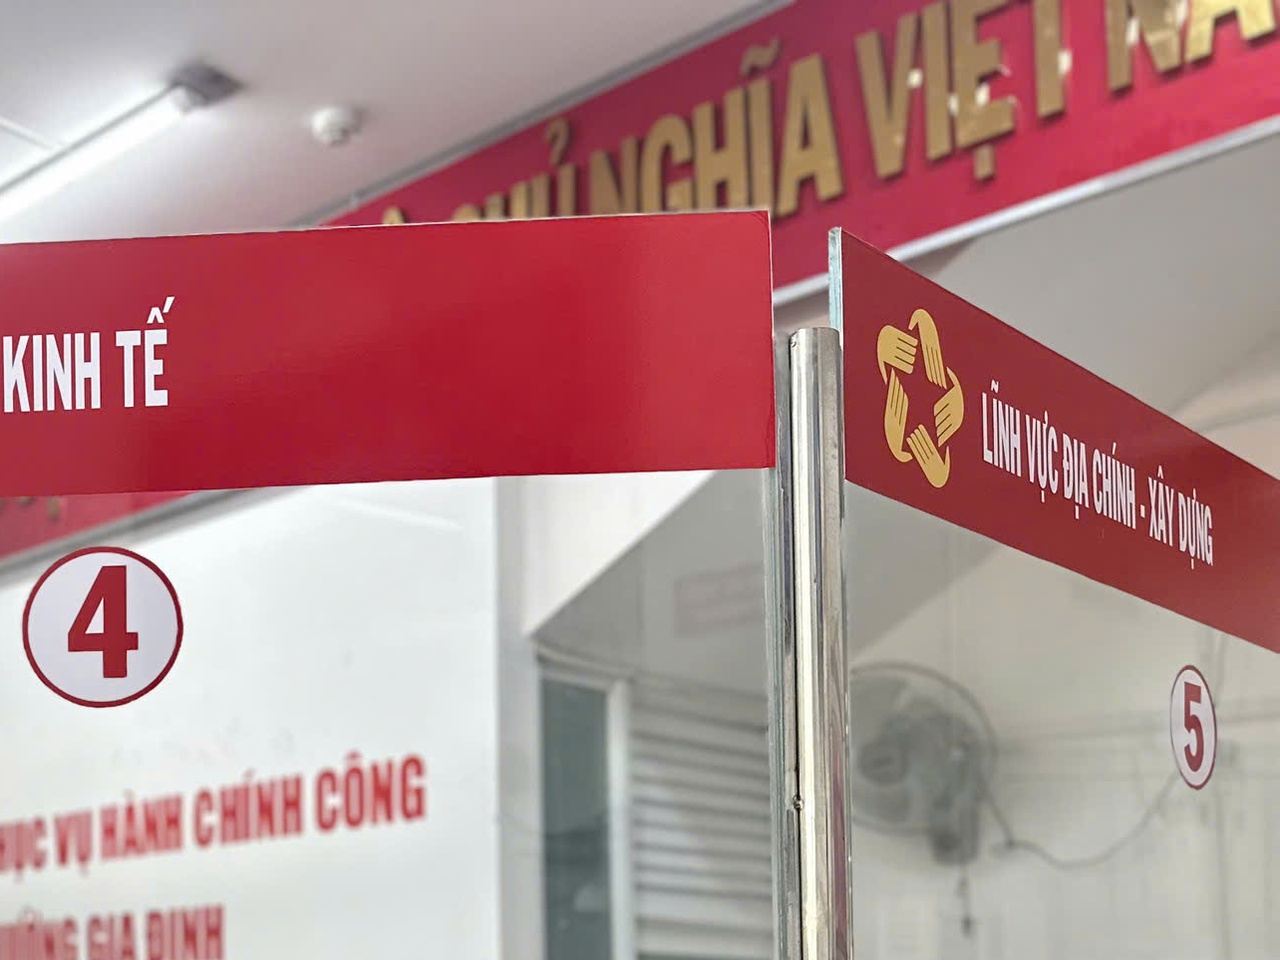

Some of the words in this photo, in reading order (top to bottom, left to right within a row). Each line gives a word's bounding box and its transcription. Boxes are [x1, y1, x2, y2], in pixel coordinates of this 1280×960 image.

[2, 331, 101, 413] KINH
[115, 296, 175, 408] TẾ
[982, 379, 1022, 478] LĨNH
[1025, 410, 1059, 503] VỰC
[1062, 433, 1090, 520] ĐỊA
[1092, 442, 1137, 530] CHÍNH
[1148, 465, 1174, 547] XÂY
[1178, 487, 1214, 570] DỰNG
[67, 565, 139, 679] 4
[1184, 681, 1205, 773] 5
[54, 809, 93, 878] VỤ
[100, 788, 183, 862] HÀNH
[195, 768, 303, 849] CHÍNH
[317, 749, 426, 834] CÔNG
